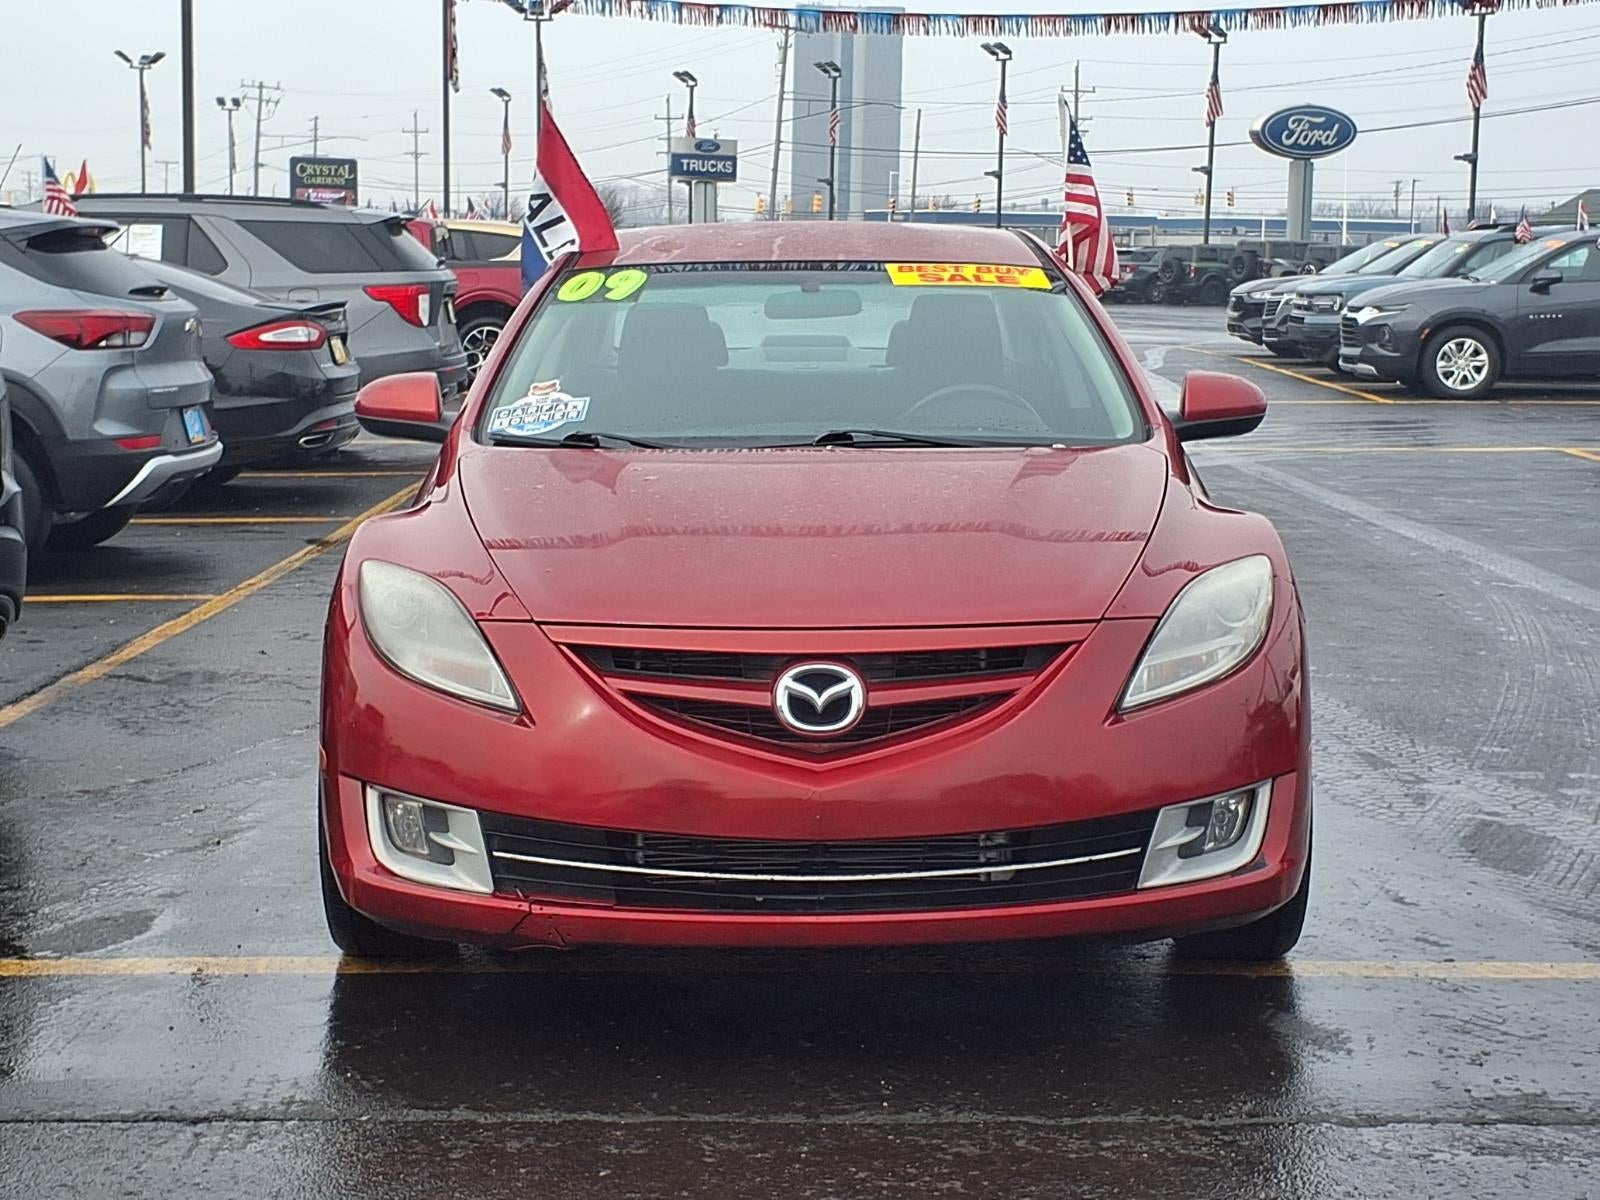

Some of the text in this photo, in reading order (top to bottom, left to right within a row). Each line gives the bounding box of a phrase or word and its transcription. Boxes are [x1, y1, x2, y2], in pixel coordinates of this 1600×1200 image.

[1281, 115, 1339, 146] Ford
[681, 159, 733, 173] TRUCKS
[897, 265, 1032, 276] BEST BUY
[557, 269, 648, 302] 09
[918, 273, 1022, 284] SALE
[497, 400, 581, 419] CARFAX
[510, 411, 580, 426] OWNER
